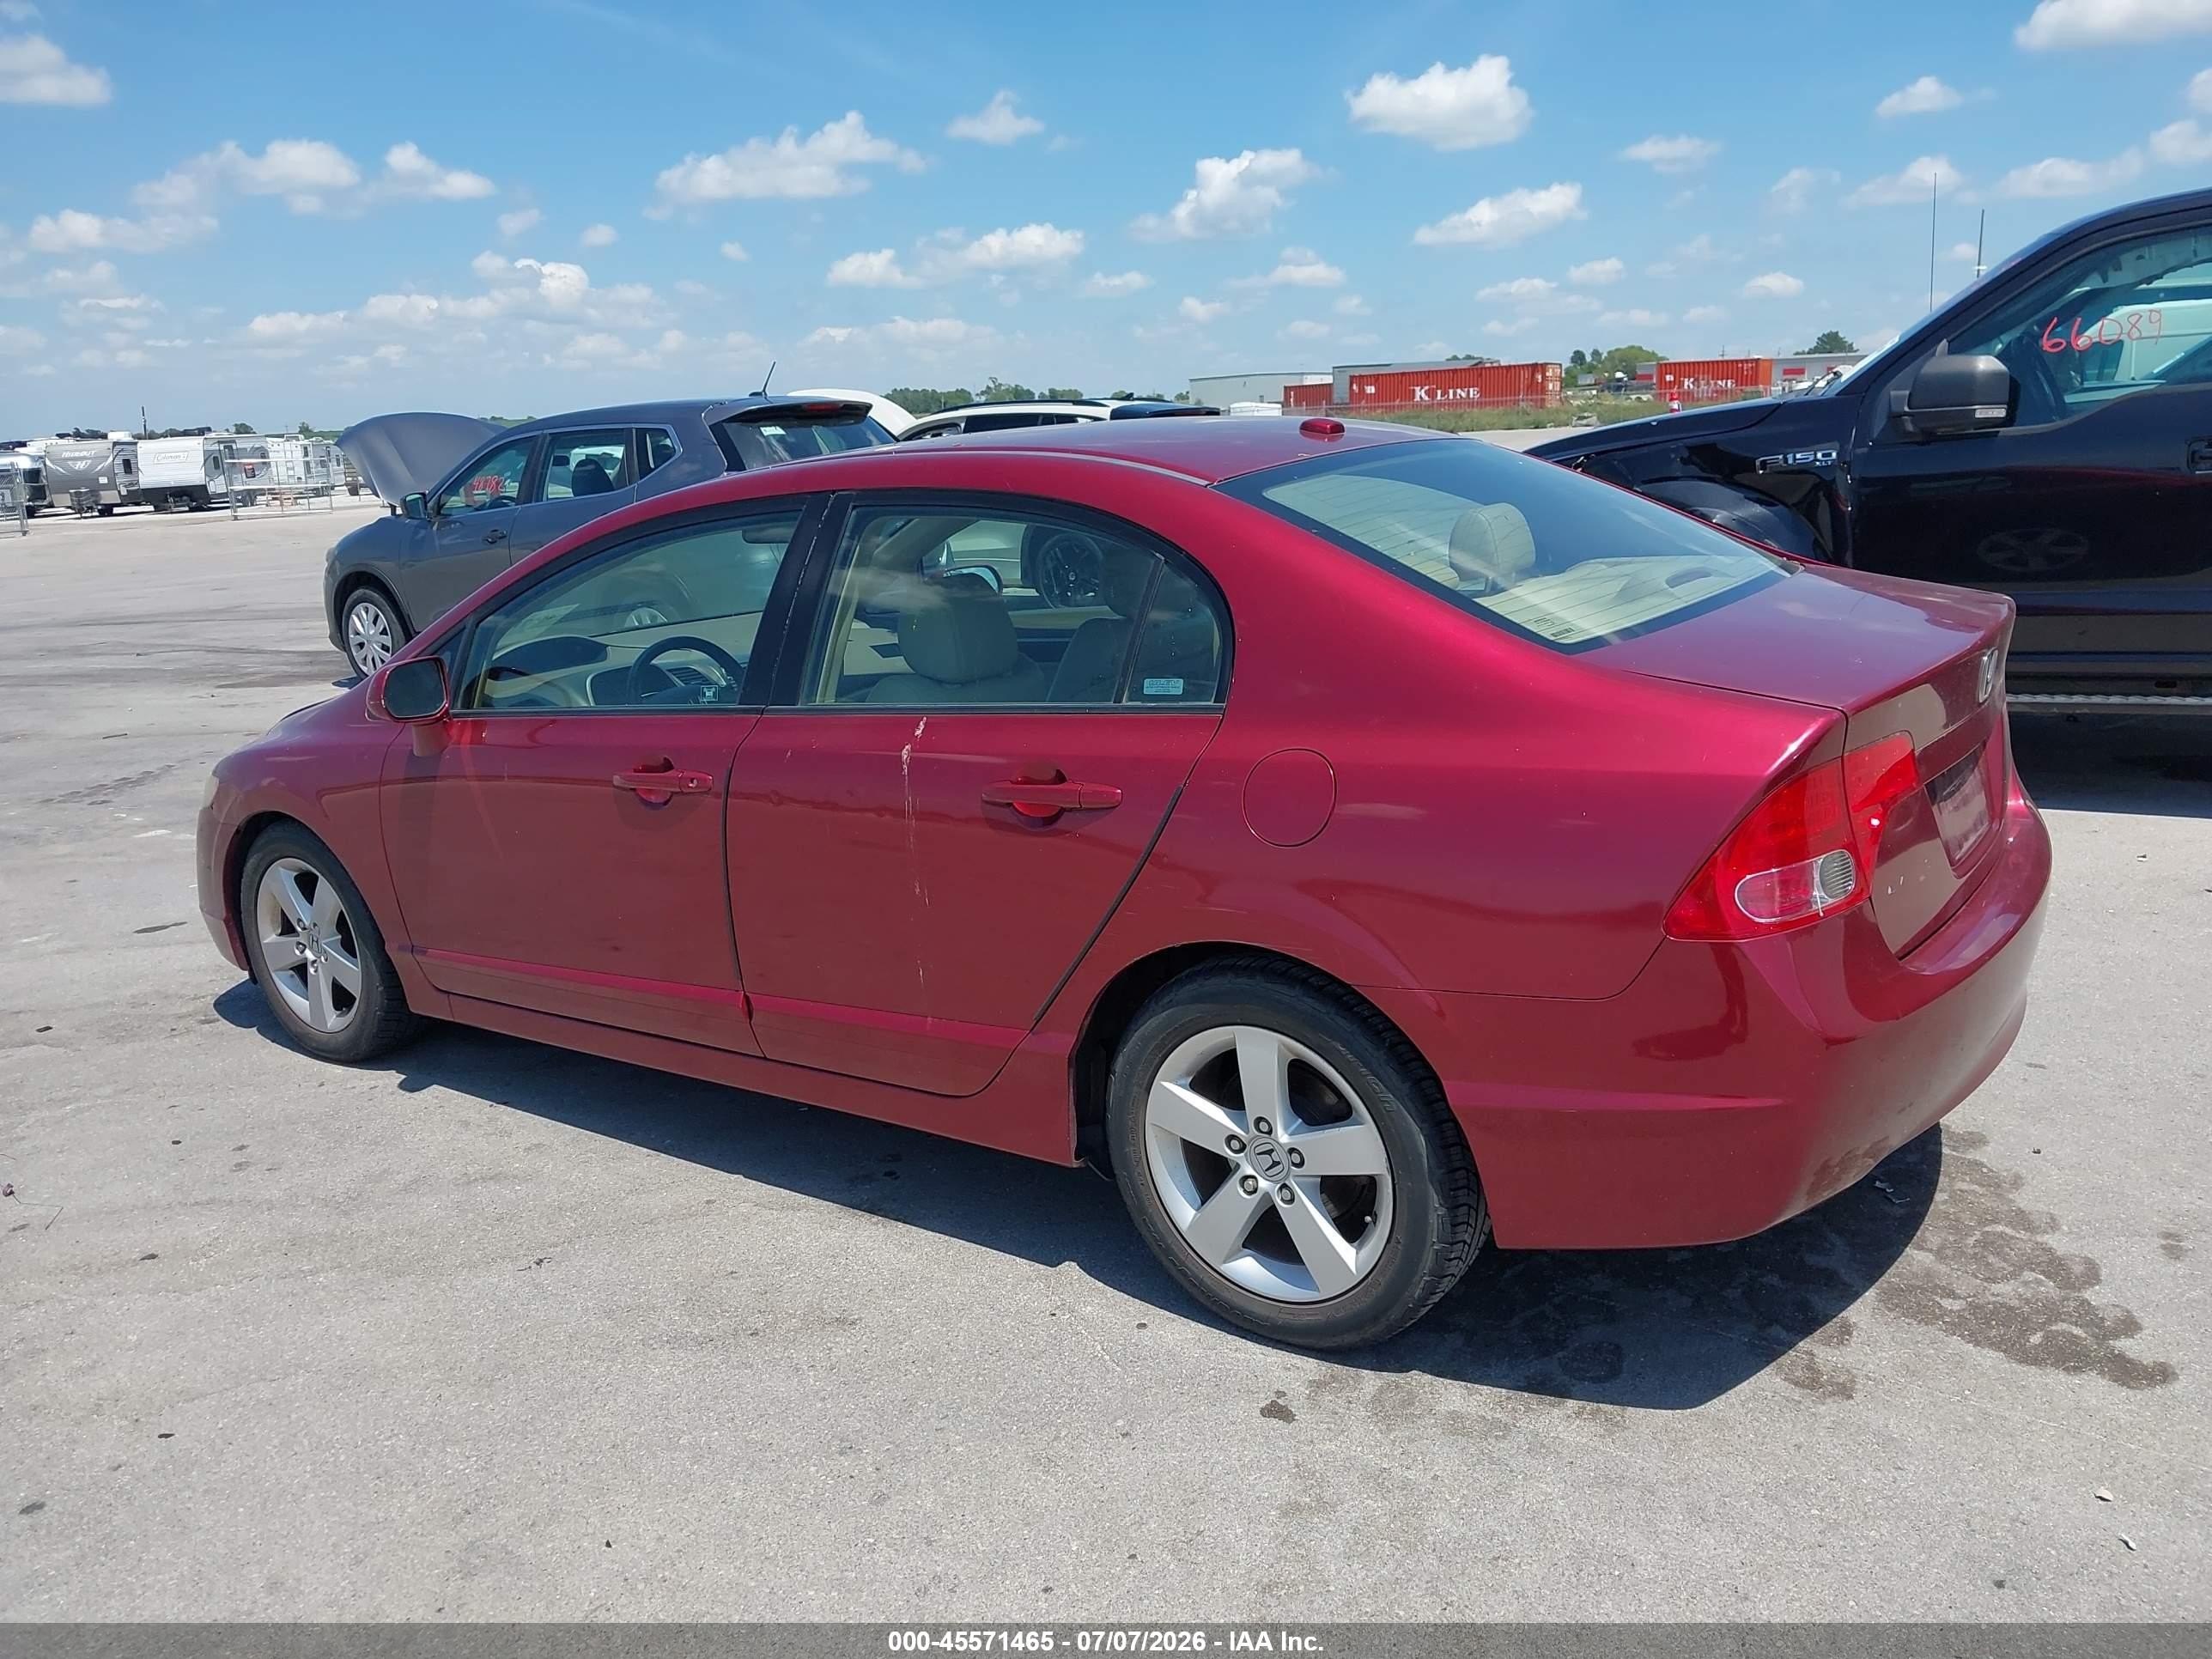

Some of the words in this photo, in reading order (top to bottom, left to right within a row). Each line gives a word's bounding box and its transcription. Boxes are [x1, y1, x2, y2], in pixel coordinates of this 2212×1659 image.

[2042, 308, 2162, 353] 66089
[1408, 385, 1437, 402] K
[1436, 386, 1481, 400] LINE
